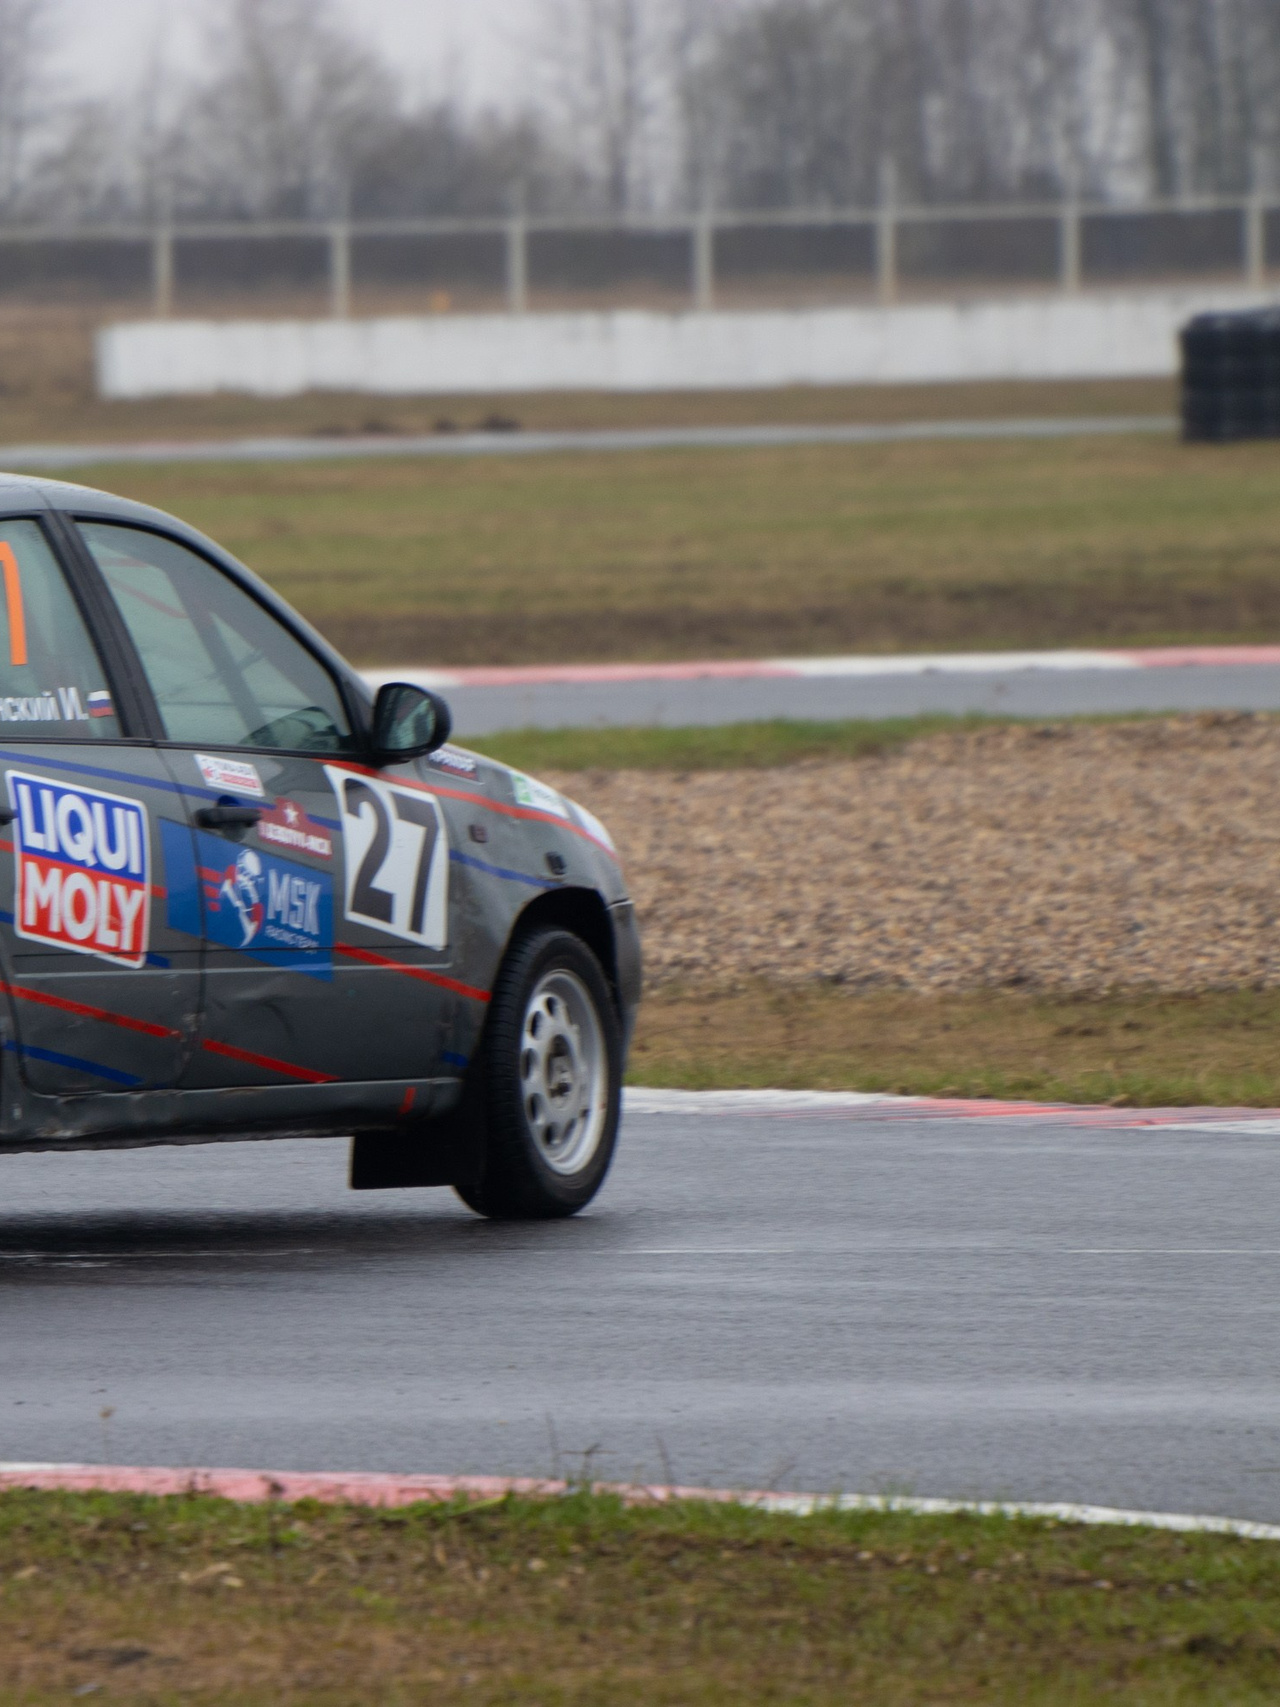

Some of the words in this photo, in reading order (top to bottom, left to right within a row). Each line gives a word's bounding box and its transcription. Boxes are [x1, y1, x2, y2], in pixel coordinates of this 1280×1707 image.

[58, 686, 90, 721] И.
[16, 783, 142, 875] LIQUI
[344, 777, 440, 935] 27
[23, 861, 145, 951] MOLY
[266, 869, 322, 936] MSK
